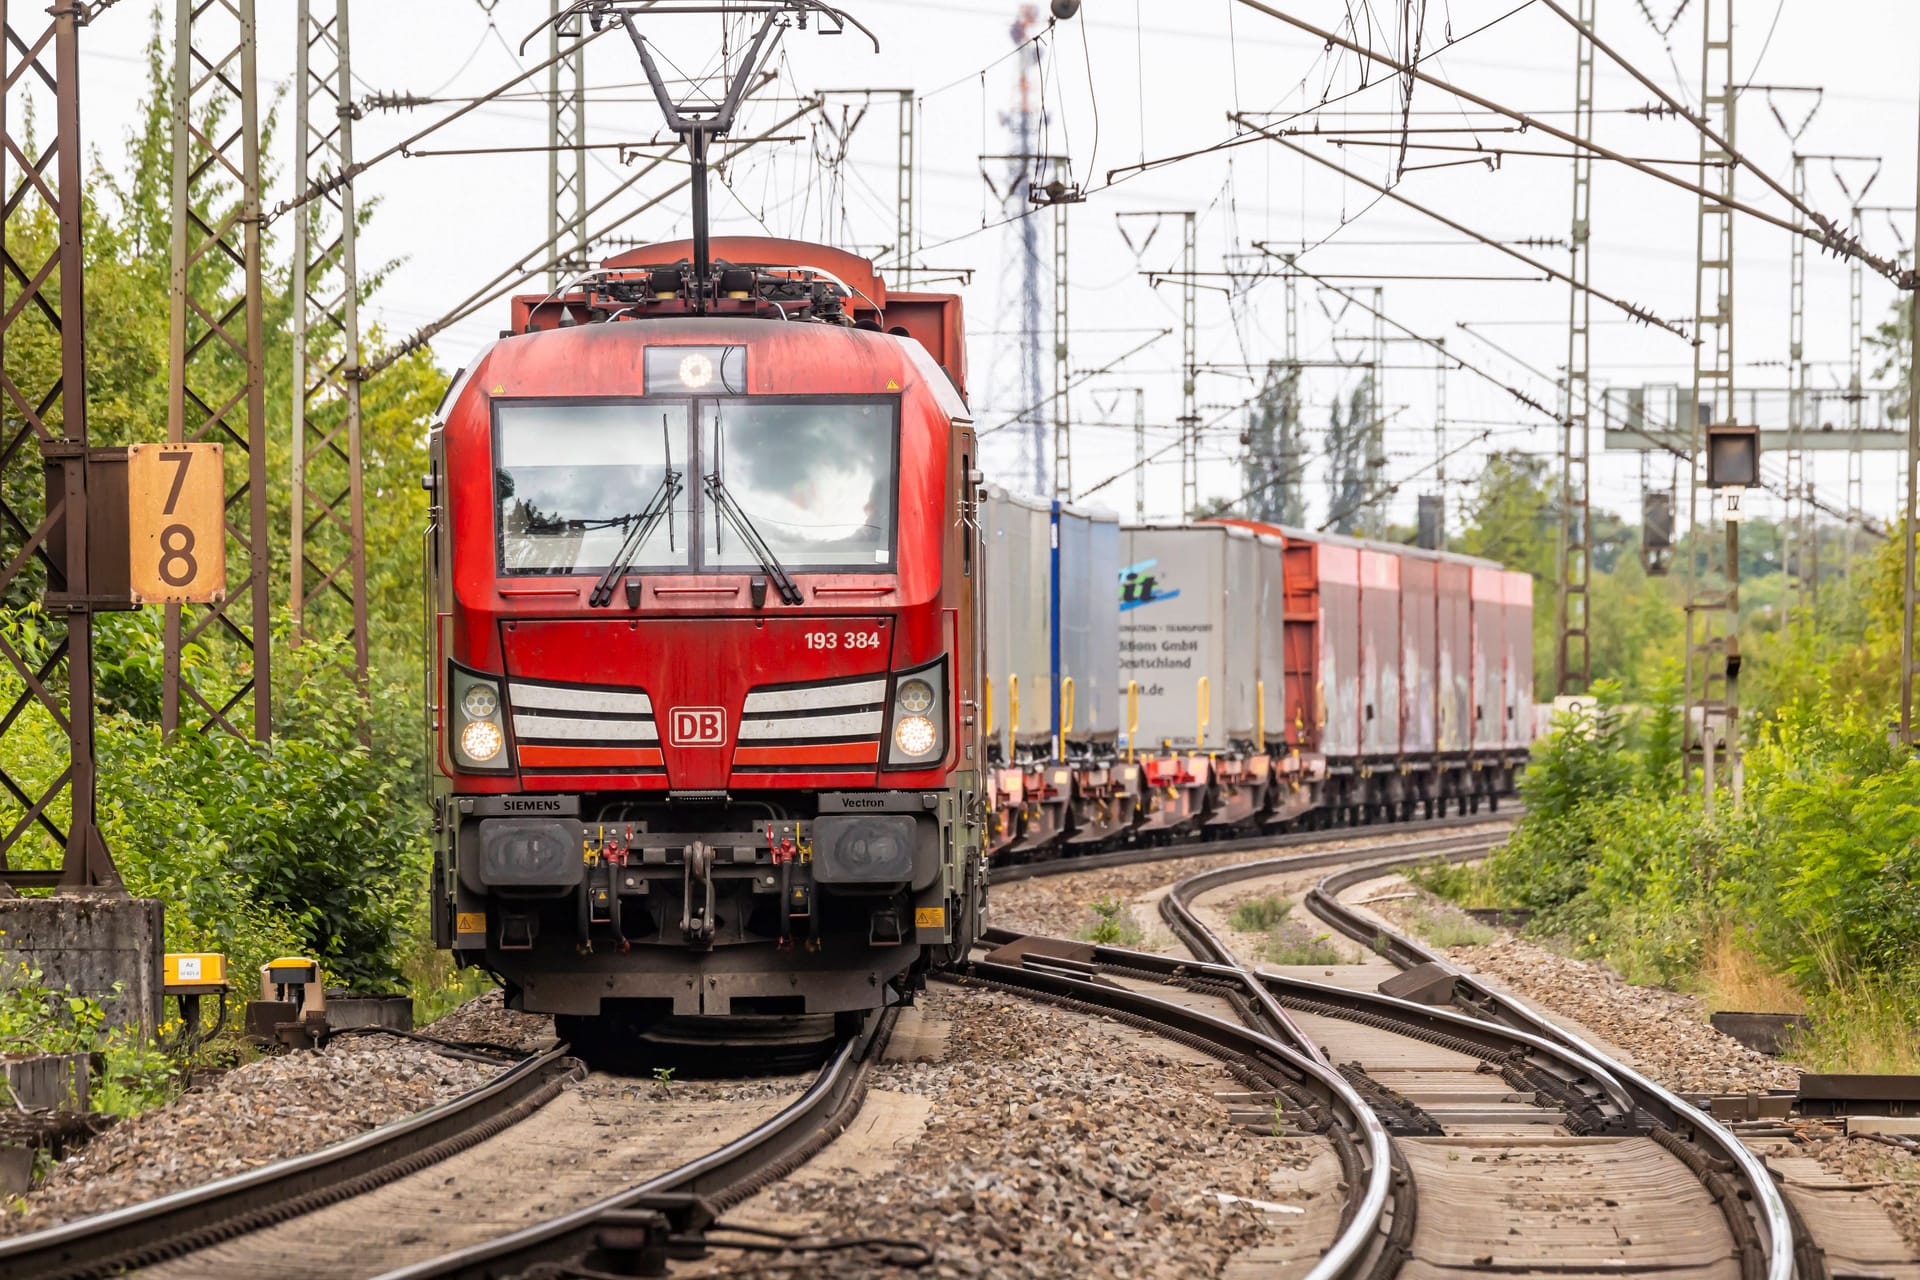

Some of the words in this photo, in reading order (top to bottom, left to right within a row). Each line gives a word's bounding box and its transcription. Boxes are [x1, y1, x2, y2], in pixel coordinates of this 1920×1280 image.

[158, 451, 193, 515] 7
[1727, 495, 1740, 511] IV
[158, 523, 198, 587] 8
[1119, 571, 1158, 604] it
[804, 632, 838, 649] 193
[844, 632, 880, 649] 384
[1161, 640, 1198, 652] GmbH
[678, 714, 719, 740] DB
[503, 800, 561, 811] SIEMENS
[842, 798, 885, 808] Vectron
